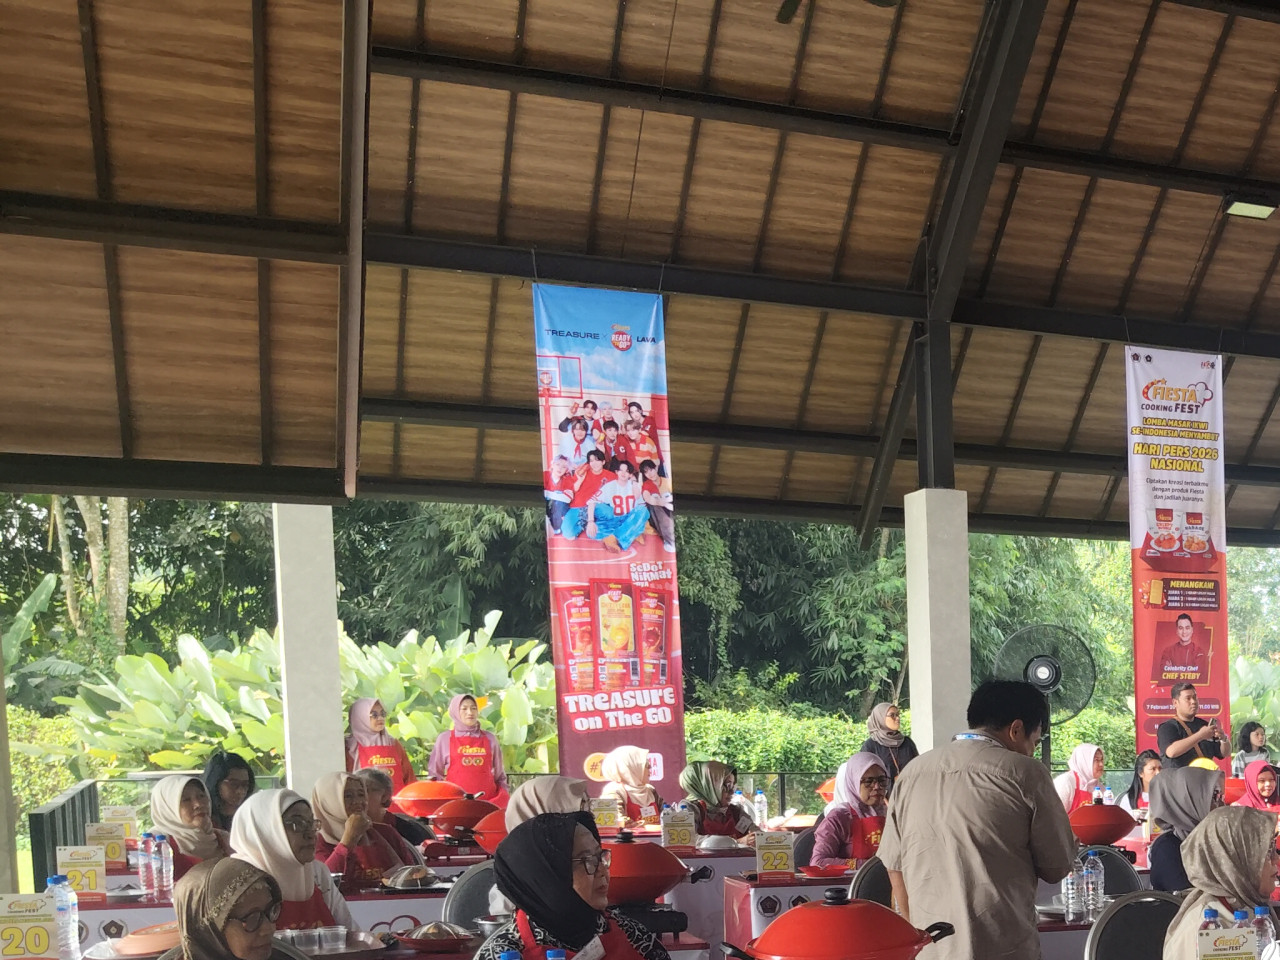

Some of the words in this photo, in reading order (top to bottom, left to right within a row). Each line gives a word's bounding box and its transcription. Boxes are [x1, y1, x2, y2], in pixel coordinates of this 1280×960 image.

[545, 329, 600, 339] TREASURE
[611, 334, 631, 342] READY
[1152, 386, 1198, 403] FIESTA
[1141, 403, 1173, 412] COOKING
[1174, 403, 1200, 414] FEST
[1143, 417, 1167, 427] LOMBA
[1167, 419, 1192, 429] MASAK
[1192, 421, 1208, 430] IKWI
[1131, 426, 1179, 438] SE-INDONESIA
[1179, 430, 1219, 440] MENYAMBUT
[1133, 442, 1161, 455] HARI
[1162, 444, 1190, 458] PERS
[1191, 446, 1219, 460] 2026
[1150, 458, 1204, 473] NASIONAL
[612, 494, 635, 516] 80
[1180, 672, 1201, 680] STEBY
[574, 714, 602, 731] on
[605, 710, 643, 727] The
[645, 707, 672, 725] GO
[372, 757, 396, 765] FIESTA
[595, 813, 616, 826] 42
[667, 829, 691, 845] 39
[762, 852, 789, 870] 22
[67, 869, 97, 891] 21
[1, 926, 50, 956] 20
